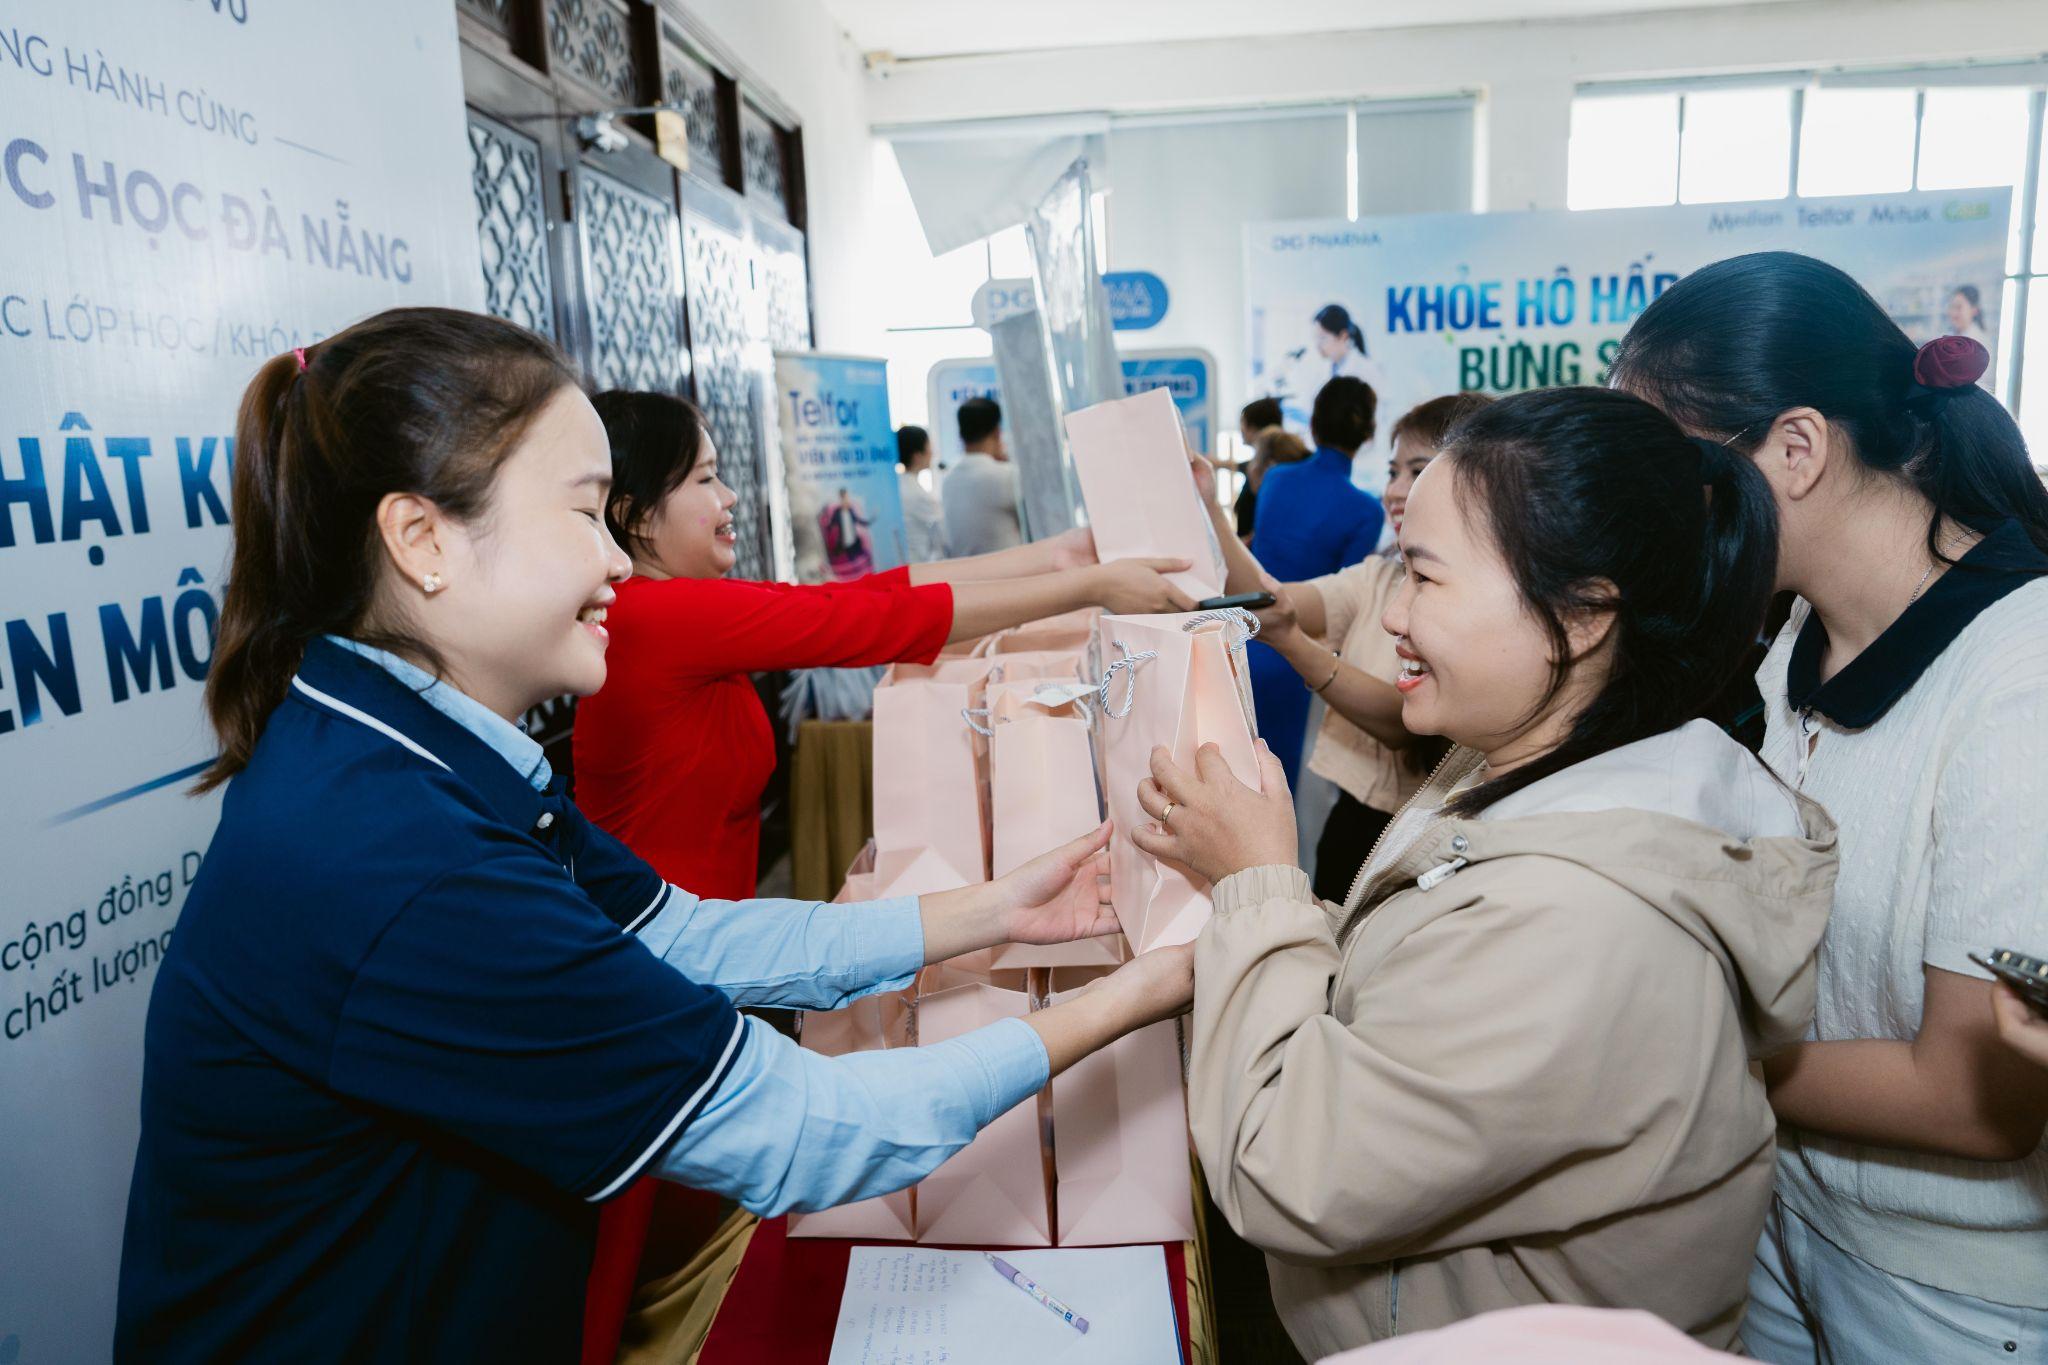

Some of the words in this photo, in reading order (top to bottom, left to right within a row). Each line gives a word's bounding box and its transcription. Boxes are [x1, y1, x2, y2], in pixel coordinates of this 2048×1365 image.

[0, 27, 53, 77] NG
[64, 47, 169, 117] HÀNH
[176, 88, 259, 146] CÙNG
[0, 137, 57, 210] C
[72, 152, 209, 251] HỌC
[220, 188, 293, 261] ĐÀ
[301, 199, 414, 285] NẴNG
[0, 295, 32, 338] C
[43, 293, 119, 345] LỚP
[1386, 264, 1503, 333] KHỎE
[1517, 266, 1575, 329] HÔ
[1460, 334, 1582, 391] BỪNG
[788, 388, 860, 427] Telfor
[175, 437, 238, 529] K
[0, 611, 83, 734] N
[98, 567, 234, 704] MÔ
[2, 908, 87, 972] cộng
[97, 869, 173, 926] đồng
[4, 968, 84, 1041] chất
